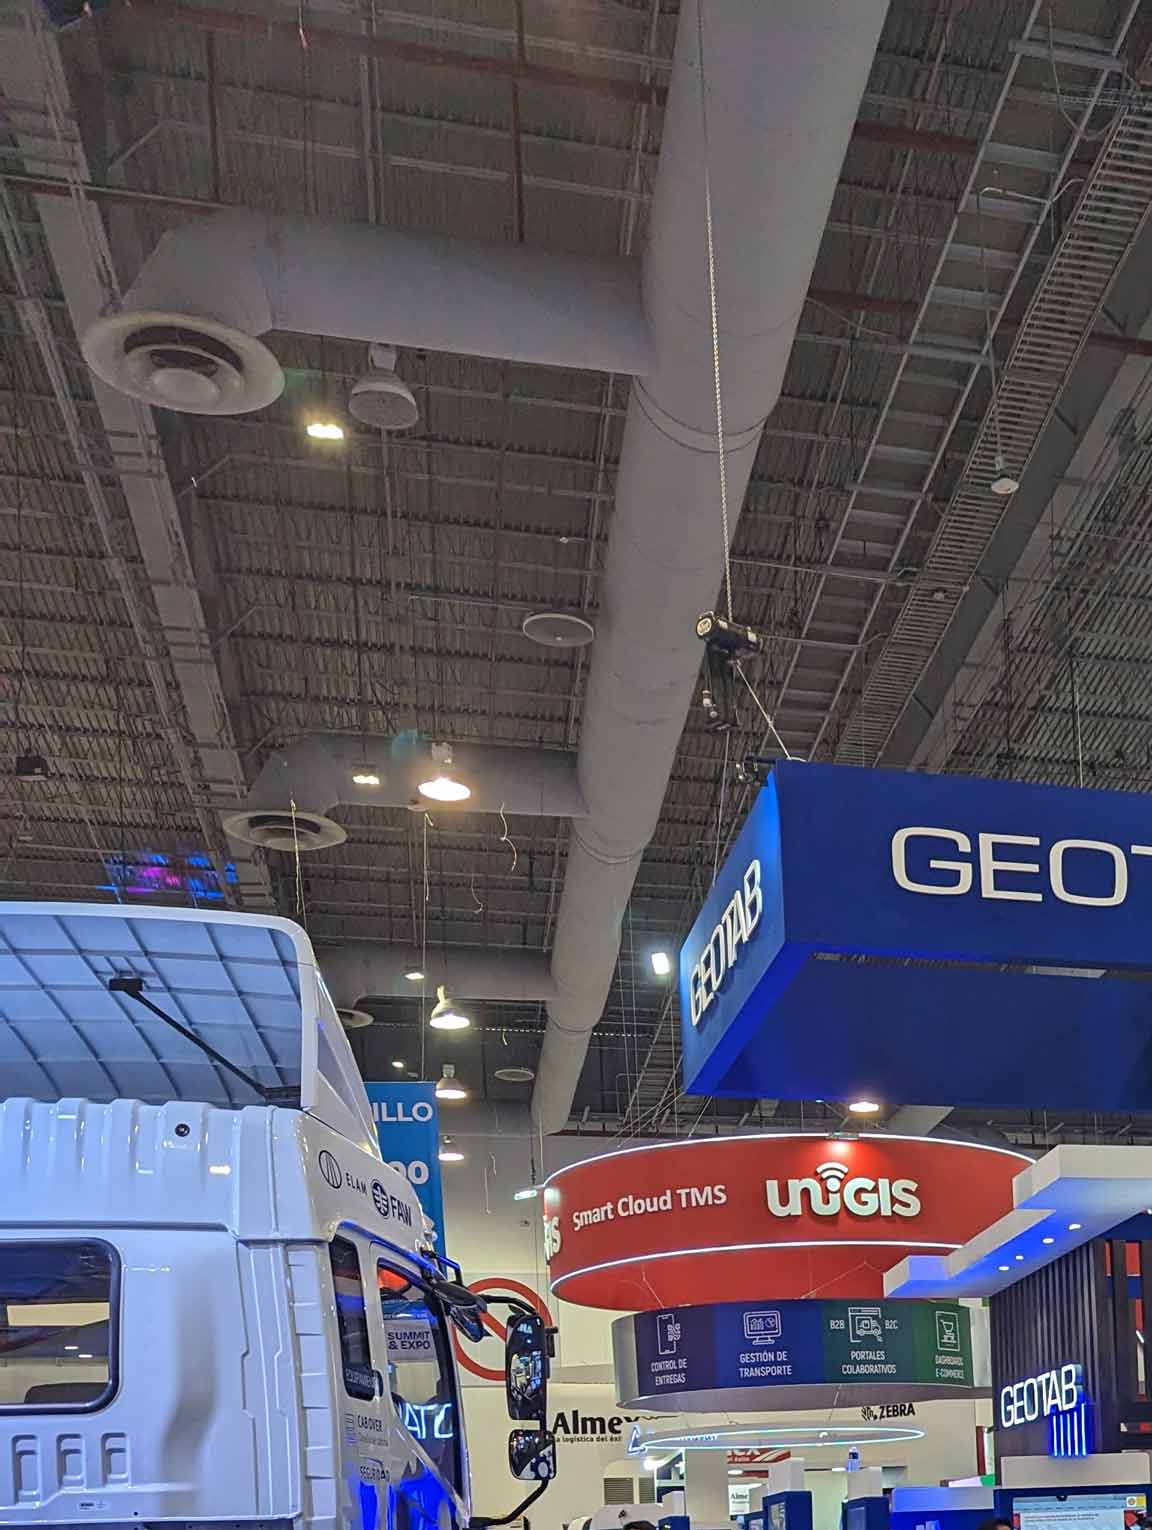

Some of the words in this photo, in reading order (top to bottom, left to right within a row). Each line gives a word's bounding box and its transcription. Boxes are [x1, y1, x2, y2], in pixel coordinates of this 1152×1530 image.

[690, 859, 763, 1027] GEOTAB
[346, 1172, 367, 1196] ELAM
[390, 1196, 412, 1227] FAW
[572, 1202, 615, 1231] Smart
[617, 1190, 672, 1217] Cloud
[676, 1185, 727, 1209] TMS
[830, 1320, 845, 1329] B2B
[885, 1320, 898, 1329] B2C
[387, 1331, 431, 1341] SUMMIT
[388, 1341, 399, 1350] &
[401, 1340, 431, 1350] EXPO
[739, 1350, 775, 1363] GESTIÓN
[776, 1351, 788, 1361] DE
[850, 1350, 886, 1361] PORTALES
[651, 1360, 677, 1373] CONTROL
[678, 1358, 687, 1369] DE
[739, 1365, 792, 1377] TRANSPORTE
[841, 1364, 897, 1375] COLABORATIVOS
[655, 1373, 686, 1385] ENTREGAS
[1000, 1364, 1077, 1428] GEOTAB
[880, 1403, 915, 1419] ZEBRA
